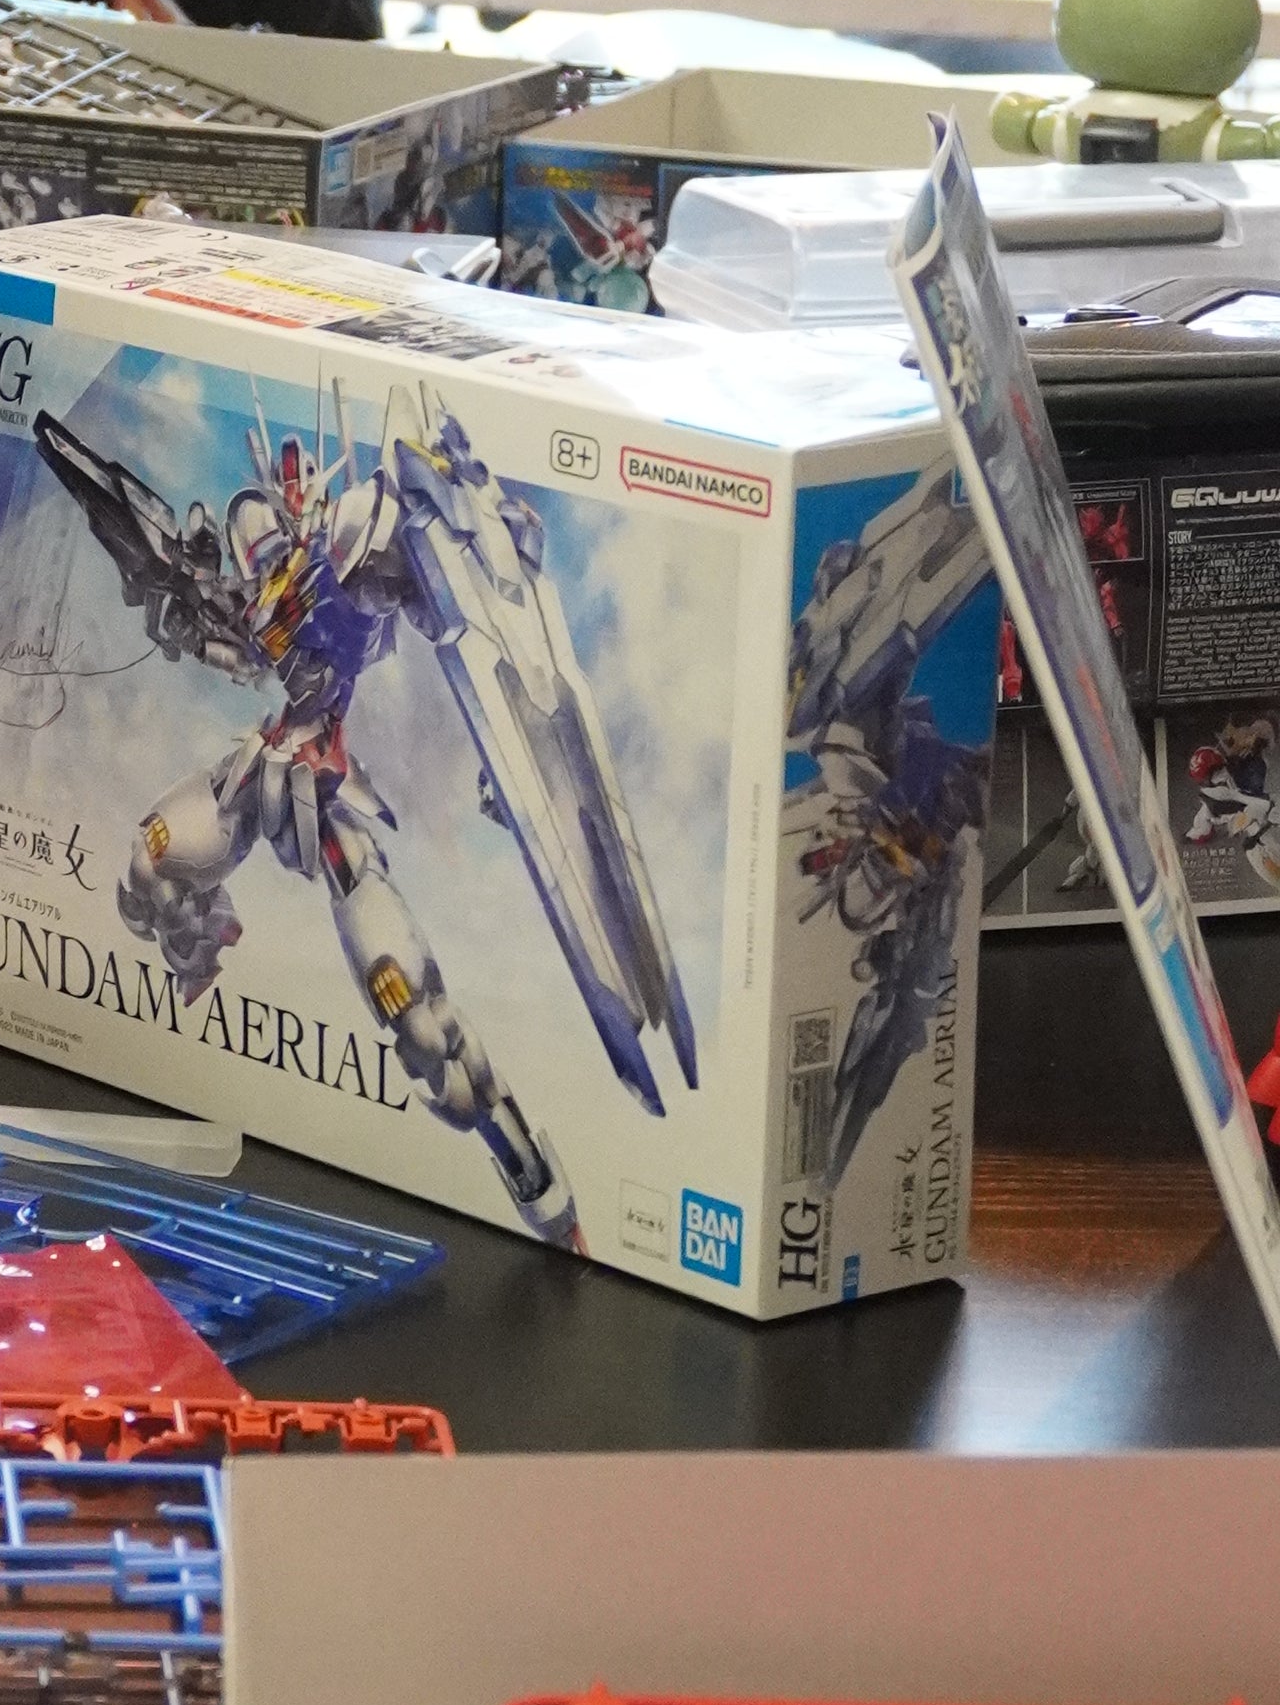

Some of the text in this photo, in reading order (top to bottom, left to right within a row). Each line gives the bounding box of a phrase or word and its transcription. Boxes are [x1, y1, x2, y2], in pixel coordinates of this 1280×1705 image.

[557, 438, 592, 469] 8+
[629, 458, 763, 505] BANDAI NAMCO
[1167, 530, 1193, 545] STORY
[197, 986, 410, 1112] AERIAL
[924, 957, 959, 1264] GUNDAM AERIAL
[686, 1201, 739, 1245] BAN
[778, 1196, 822, 1290] HG
[685, 1233, 727, 1272] DAI
